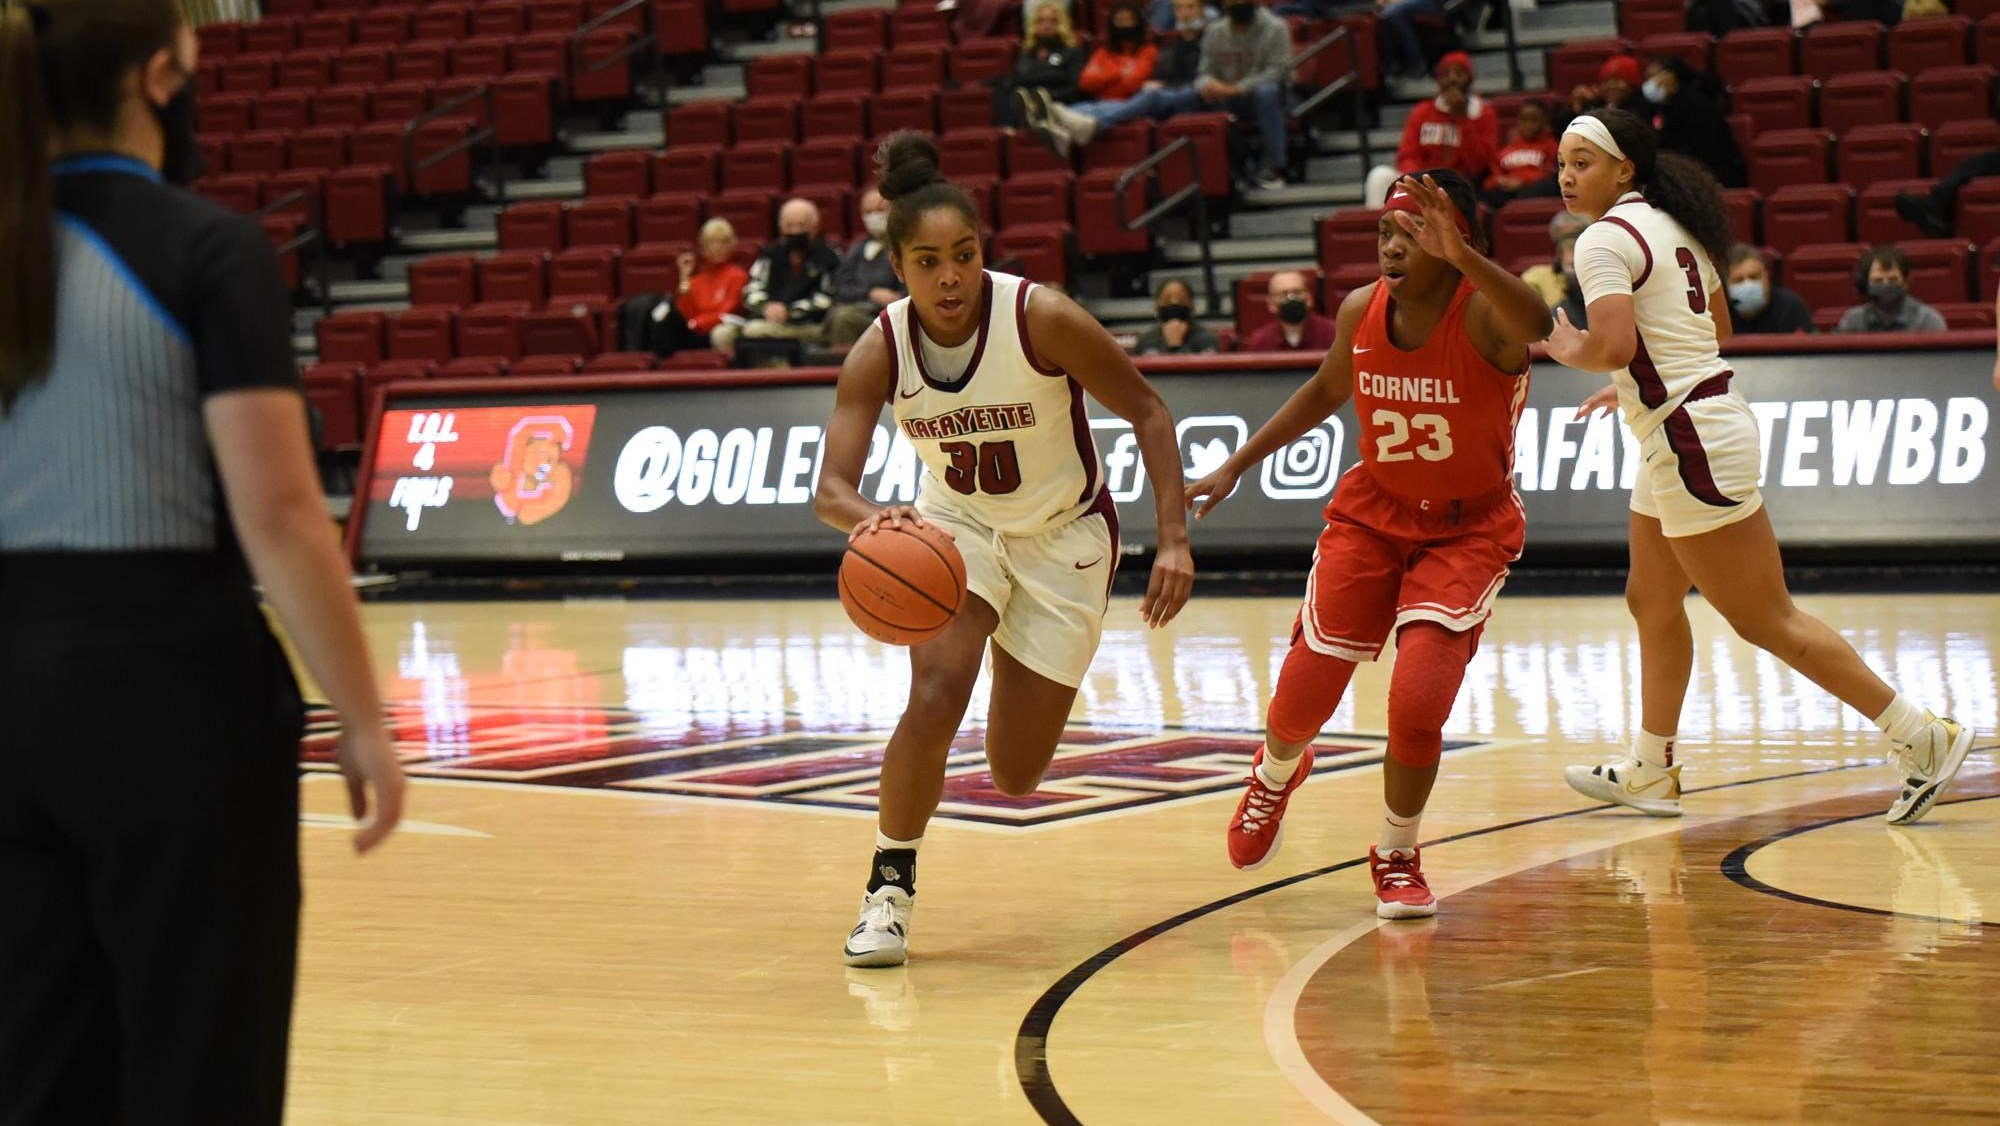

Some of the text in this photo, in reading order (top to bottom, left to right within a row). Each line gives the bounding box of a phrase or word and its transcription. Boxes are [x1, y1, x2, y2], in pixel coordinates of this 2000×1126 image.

[1675, 247, 1706, 314] 3
[1358, 371, 1460, 404] CORNELL
[900, 401, 1036, 440] LAFAYETTE
[1372, 408, 1454, 463] 23
[614, 424, 927, 513] @GOLEPA
[940, 440, 1022, 495] 30
[1420, 499, 1430, 511] C
